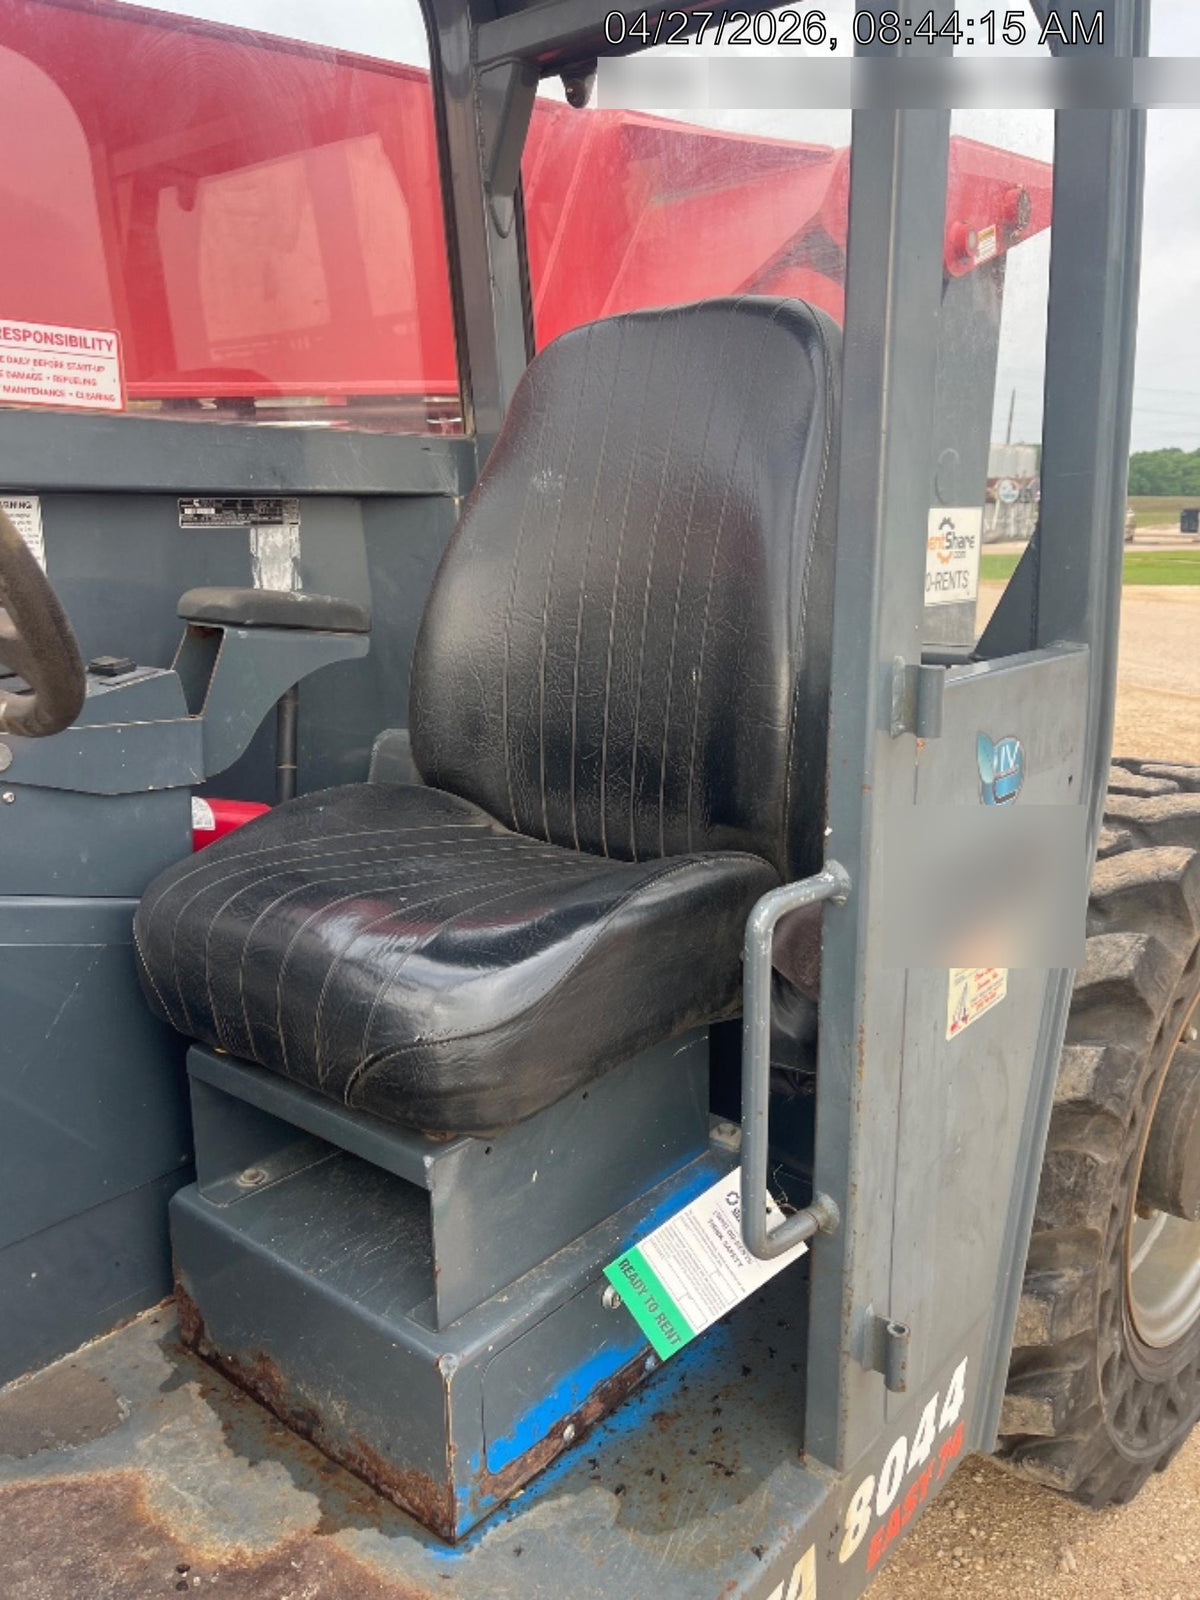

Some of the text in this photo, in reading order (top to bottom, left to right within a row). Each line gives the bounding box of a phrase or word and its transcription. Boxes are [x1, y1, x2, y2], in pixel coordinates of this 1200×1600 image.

[7, 355, 30, 366] DAILY
[33, 358, 64, 369] BEFORE
[3, 384, 65, 397] MAINTENANCE
[618, 1257, 683, 1346] READY TO RENT
[838, 1355, 968, 1564] 8044
